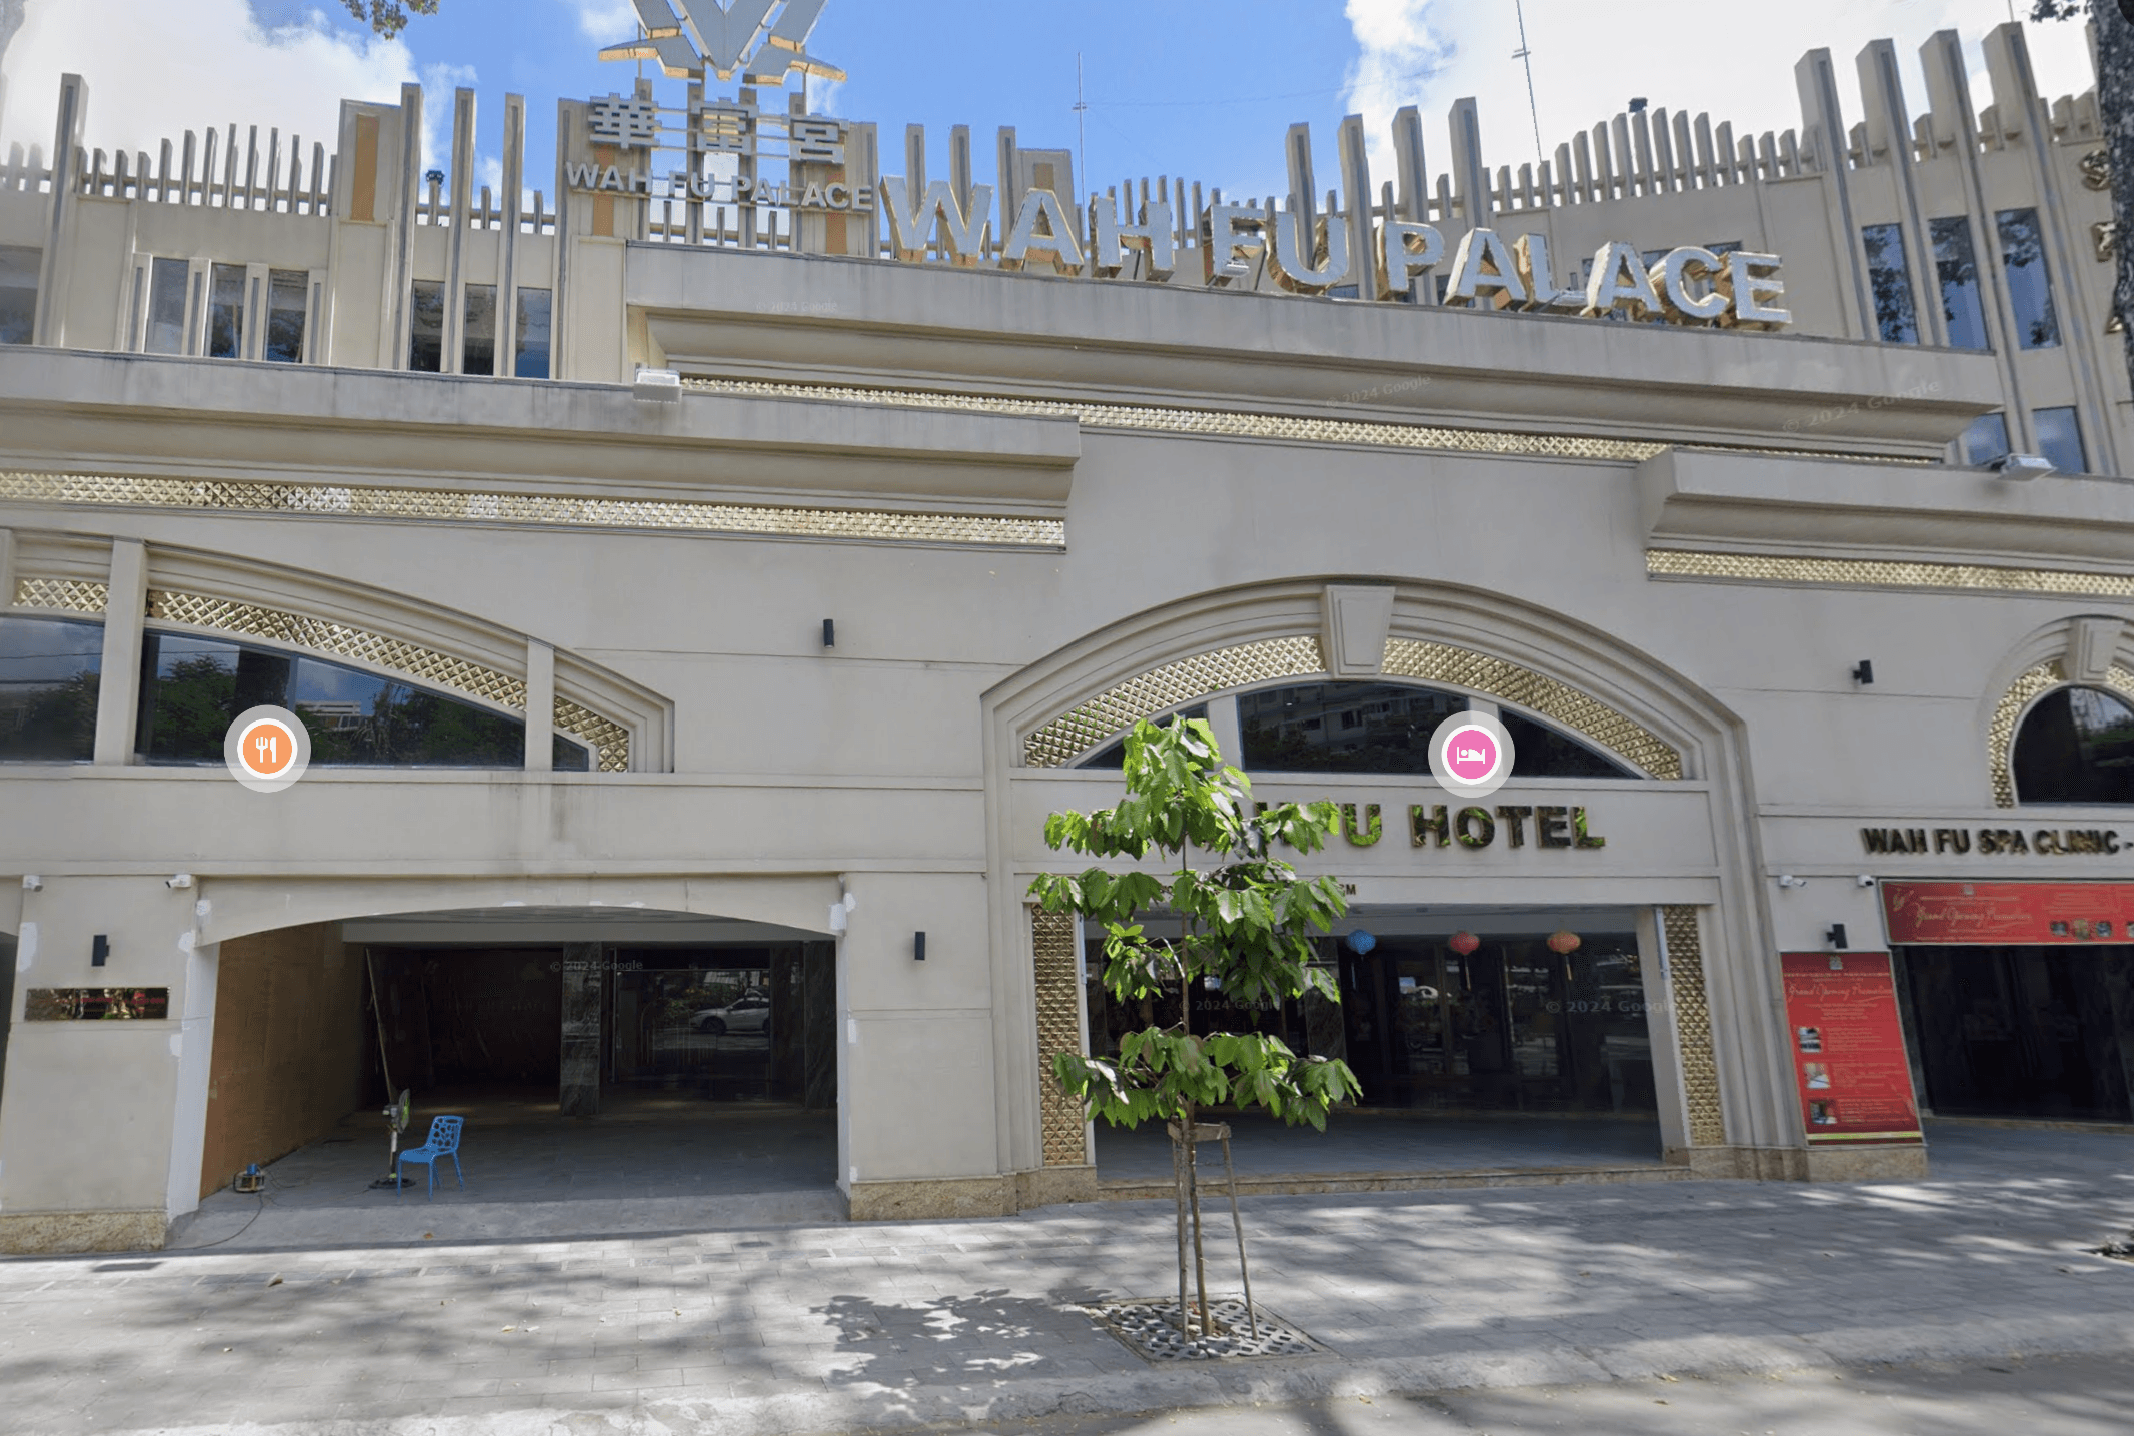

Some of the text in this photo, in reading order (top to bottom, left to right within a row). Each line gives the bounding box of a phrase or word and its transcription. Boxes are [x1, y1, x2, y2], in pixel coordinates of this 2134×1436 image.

[566, 161, 873, 211] WAH FU PALACE
[879, 174, 1792, 333] WAH FU PALACE
[1408, 803, 1606, 849] HOTEL
[1860, 828, 1928, 854] WAH
[1933, 828, 1971, 855] FU
[1978, 828, 2029, 855] SPA
